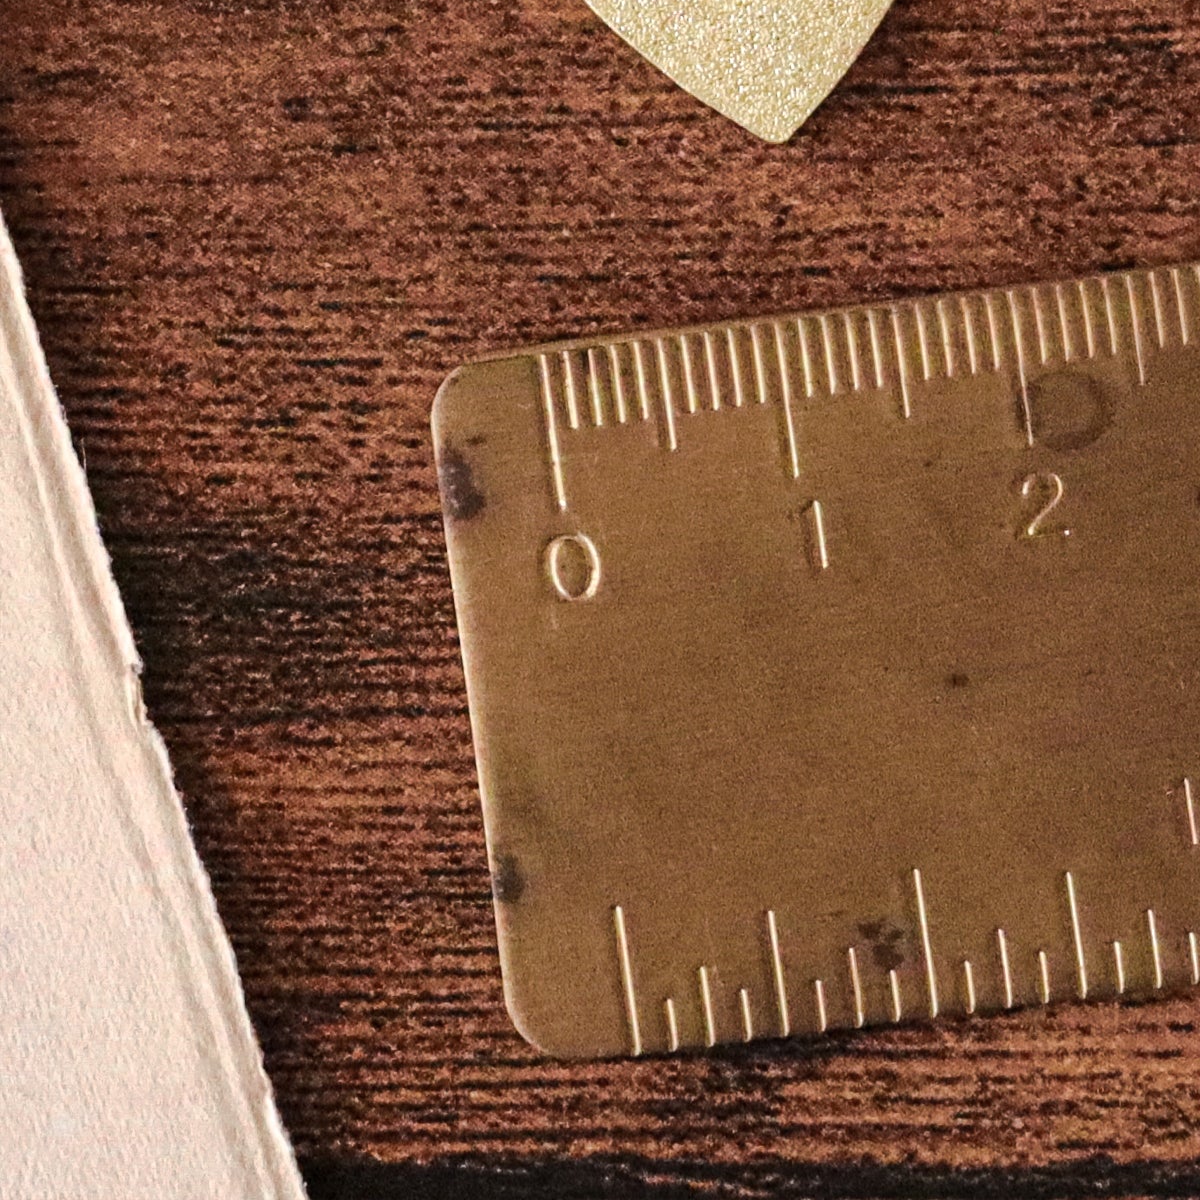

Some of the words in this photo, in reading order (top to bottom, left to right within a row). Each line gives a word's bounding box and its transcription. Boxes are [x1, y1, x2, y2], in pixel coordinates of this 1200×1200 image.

[548, 532, 601, 600] 0
[804, 499, 829, 569] 1
[1020, 472, 1071, 537] 2
